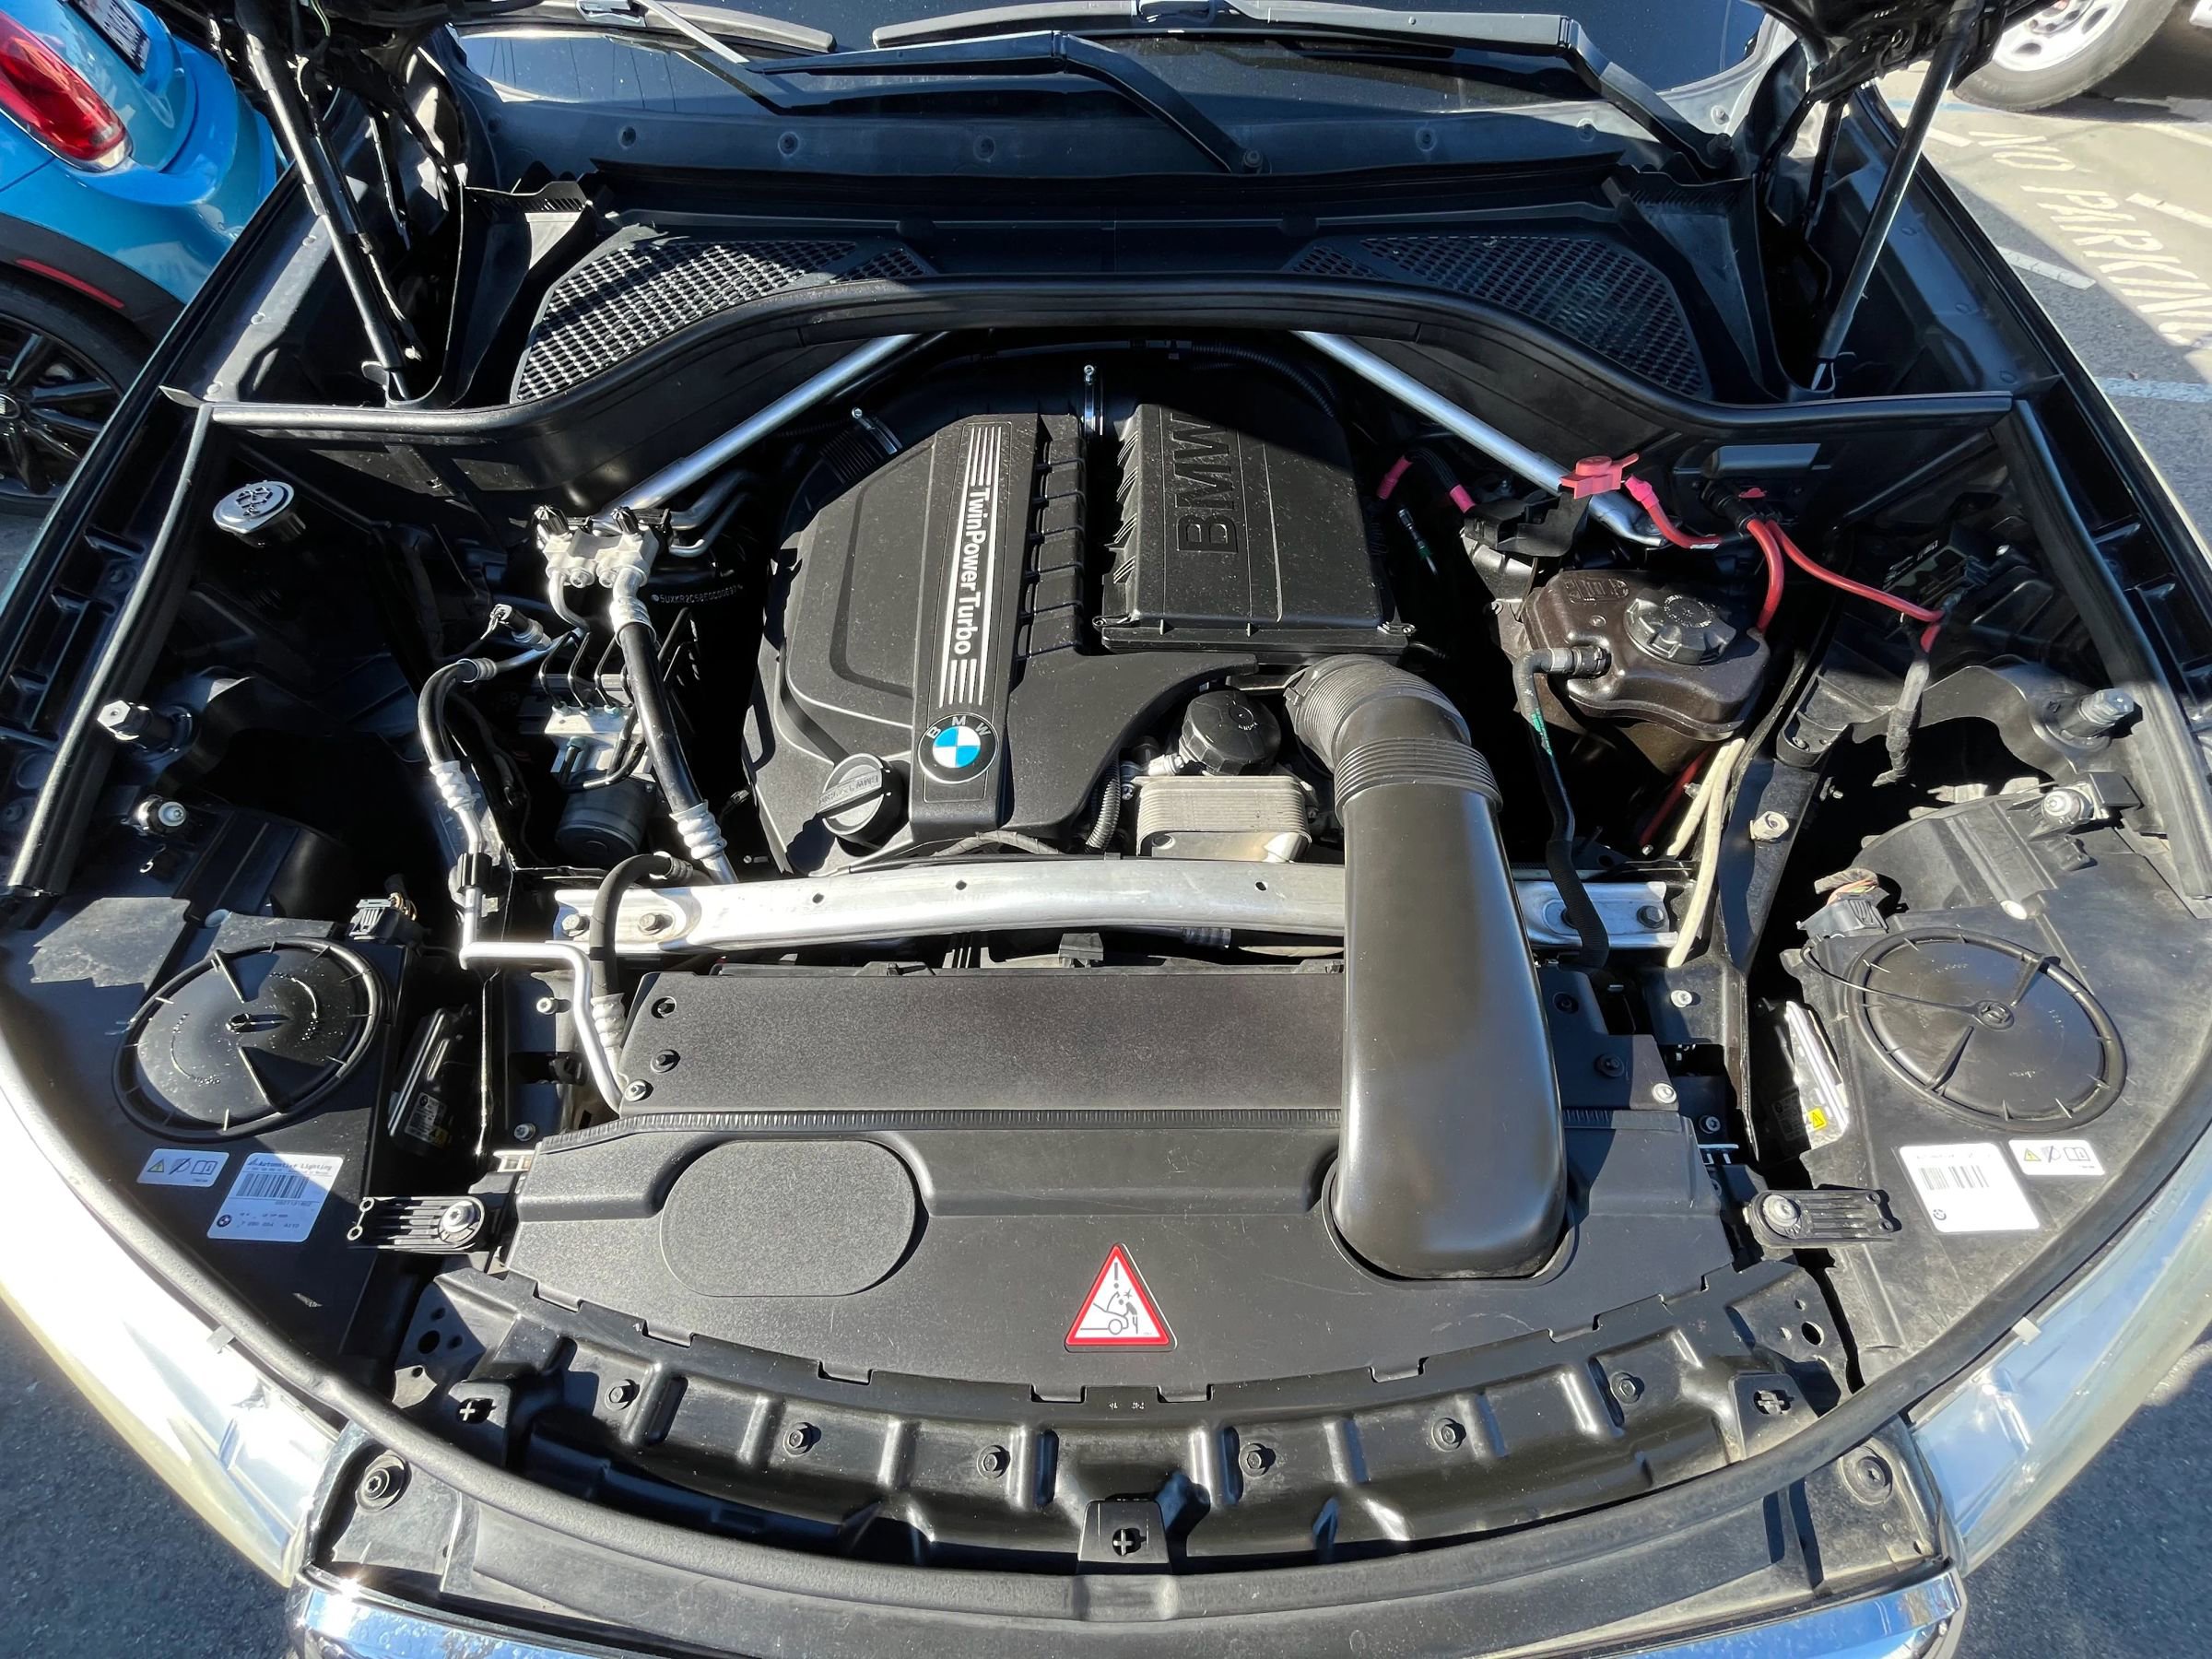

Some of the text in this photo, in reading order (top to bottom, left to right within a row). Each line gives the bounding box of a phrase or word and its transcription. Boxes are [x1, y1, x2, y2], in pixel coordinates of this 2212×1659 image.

[1969, 131, 2077, 171] NO
[1169, 411, 1239, 553] BMW
[953, 488, 990, 655] TwinPower Turbo
[926, 715, 992, 739] BMW
